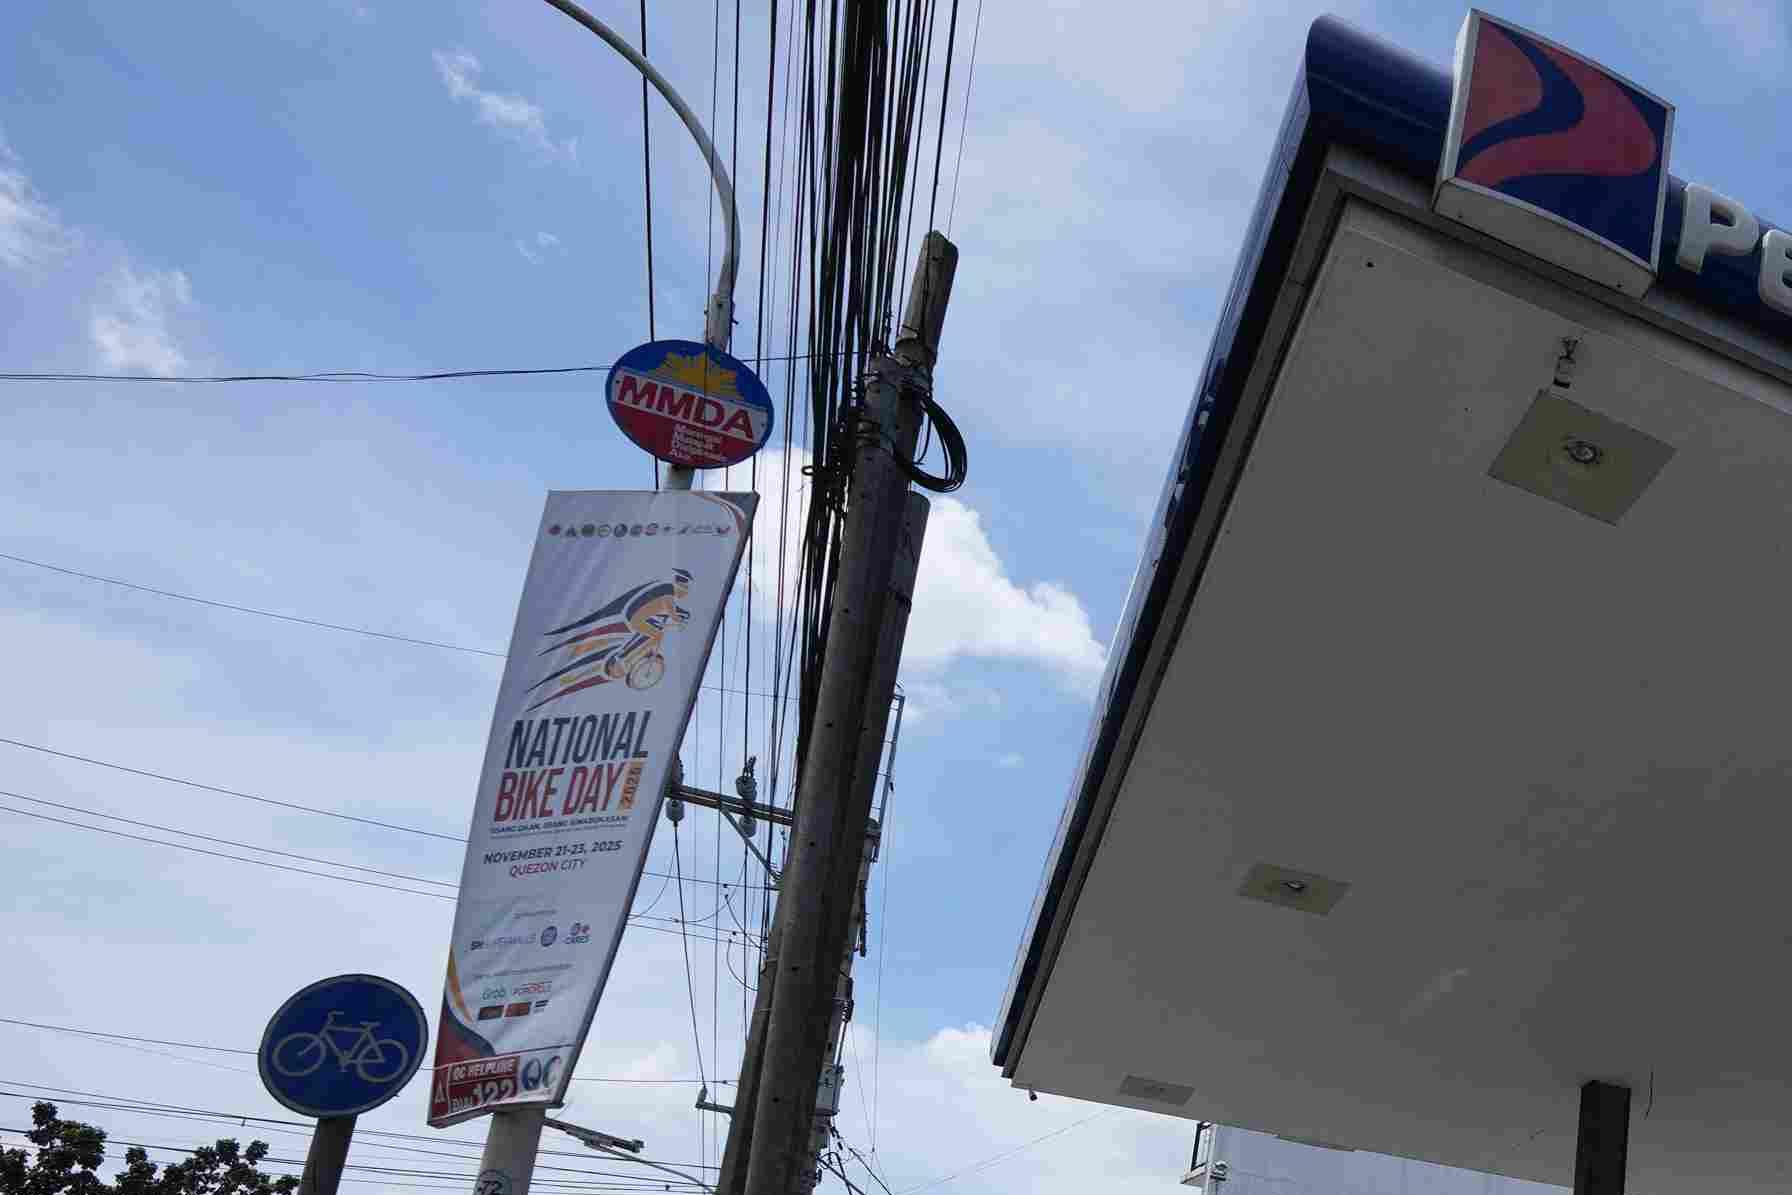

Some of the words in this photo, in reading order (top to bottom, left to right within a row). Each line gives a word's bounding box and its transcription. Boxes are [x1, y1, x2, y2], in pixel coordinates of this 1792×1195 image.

[617, 374, 754, 441] MMDA
[504, 711, 652, 768] NATIONAL
[494, 768, 565, 822] BIKE
[562, 761, 626, 816] DAY
[484, 847, 553, 864] NOVEMBER
[592, 840, 624, 852] 2025
[510, 861, 560, 878] QUEZON
[561, 858, 586, 871] CITY
[468, 1058, 514, 1076] HELPLINE
[522, 1056, 562, 1090] QC
